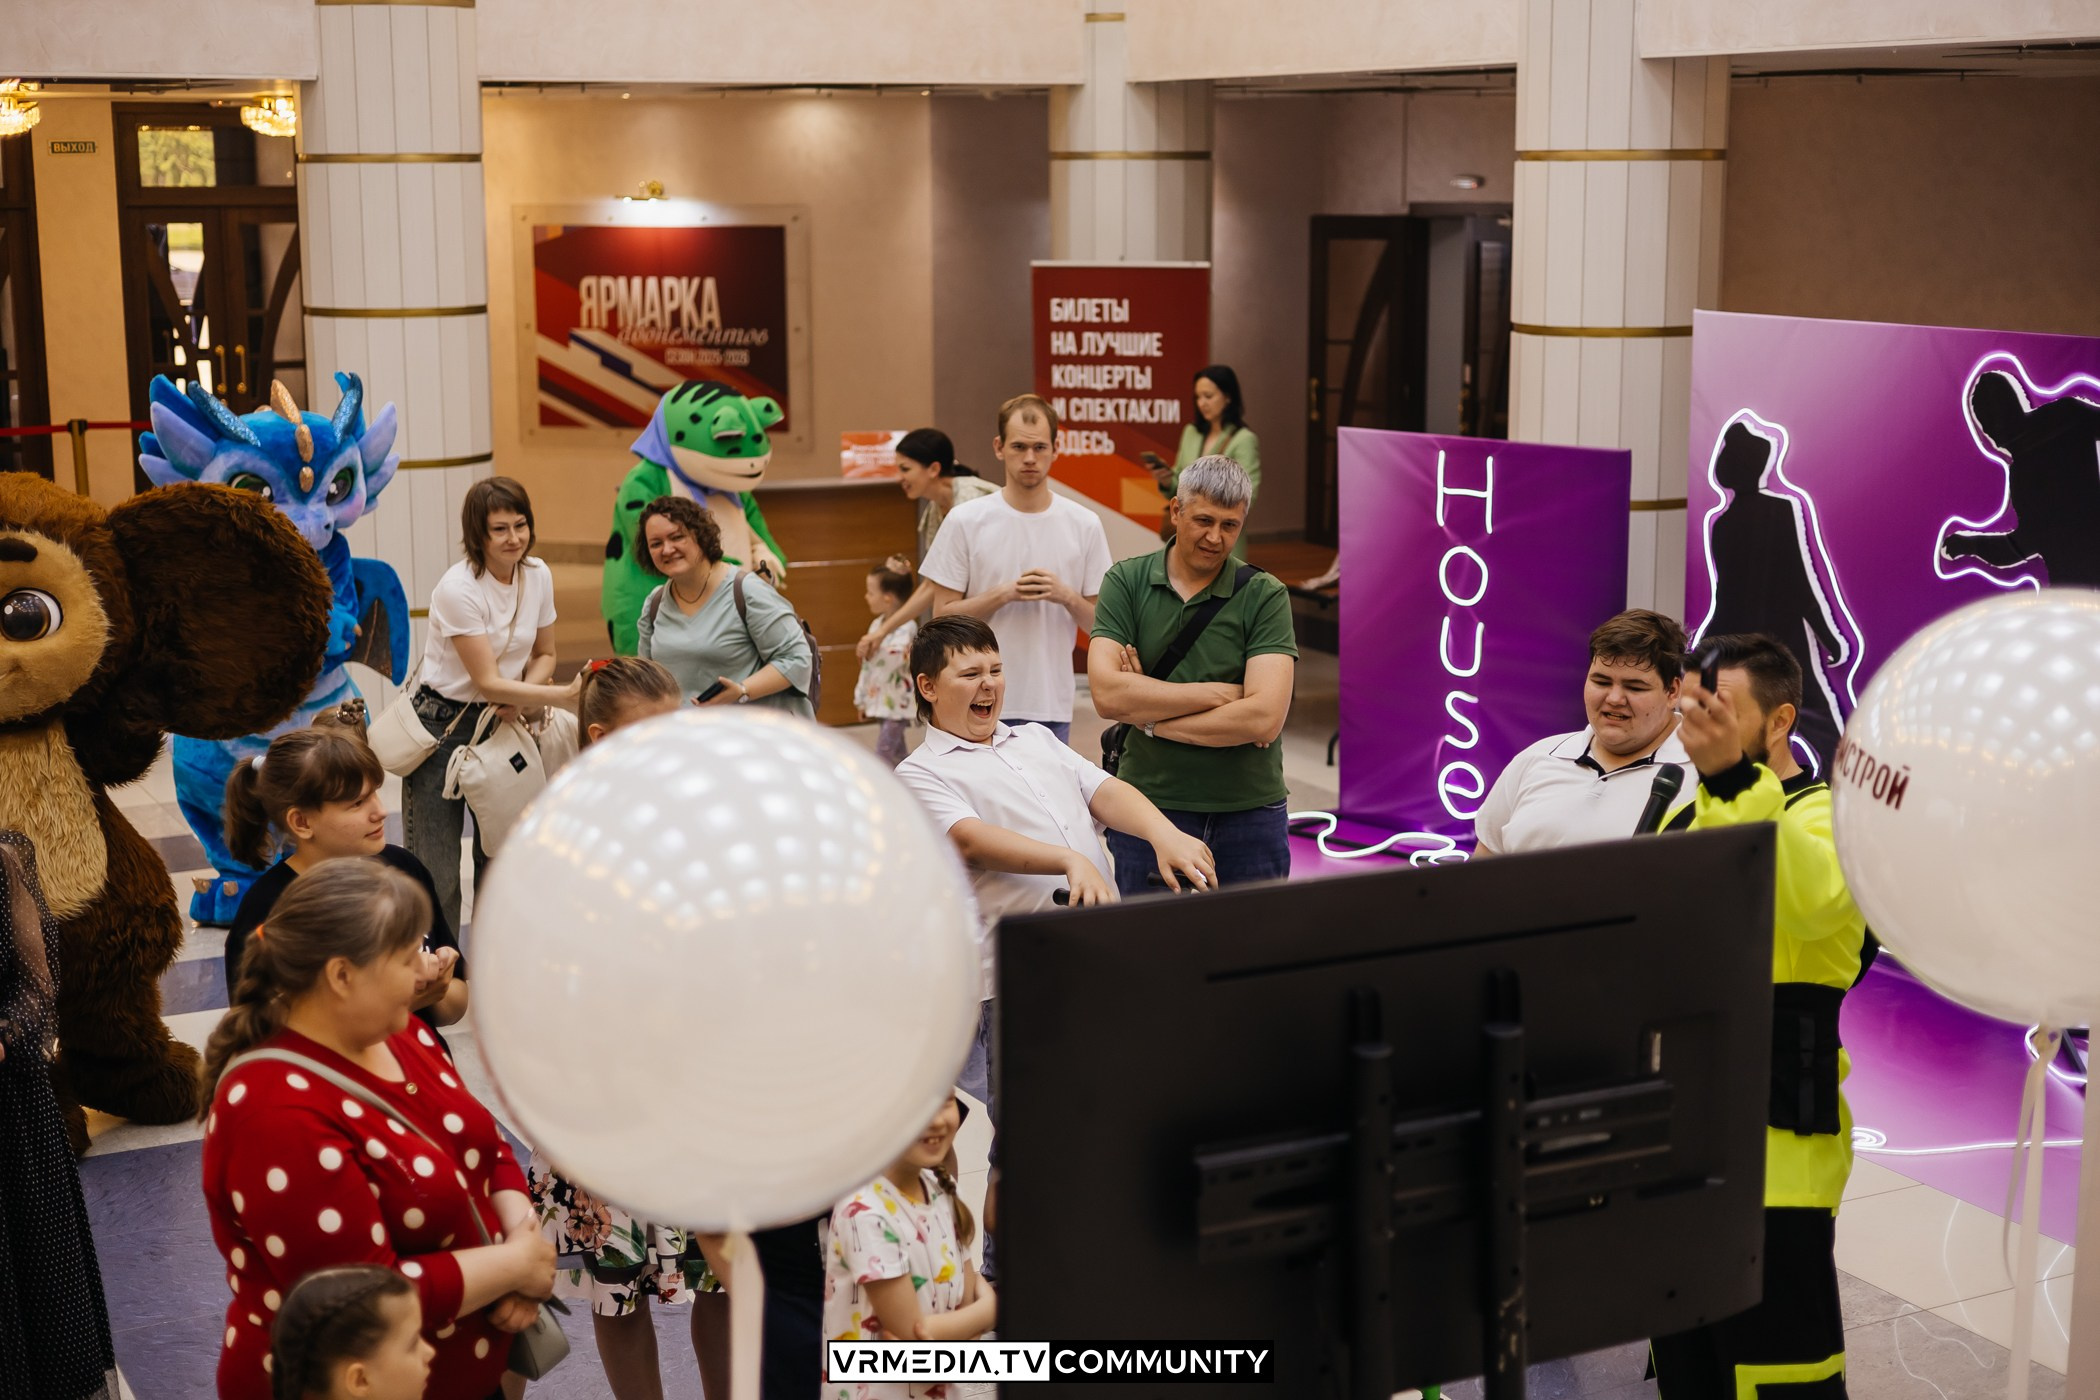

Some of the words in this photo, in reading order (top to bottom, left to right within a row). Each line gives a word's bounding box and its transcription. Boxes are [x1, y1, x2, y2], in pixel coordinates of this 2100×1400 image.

[53, 142, 94, 153] ВЫХОД
[579, 275, 722, 329] ЯРМАРКА
[1050, 298, 1130, 323] БИЛЕТЫ
[1051, 331, 1077, 355] НА
[1080, 332, 1163, 357] ЛУЧШИЕ
[1052, 364, 1152, 391] КОНЦЕРТЫ
[1069, 397, 1180, 423] СПЕКТАКЛИ
